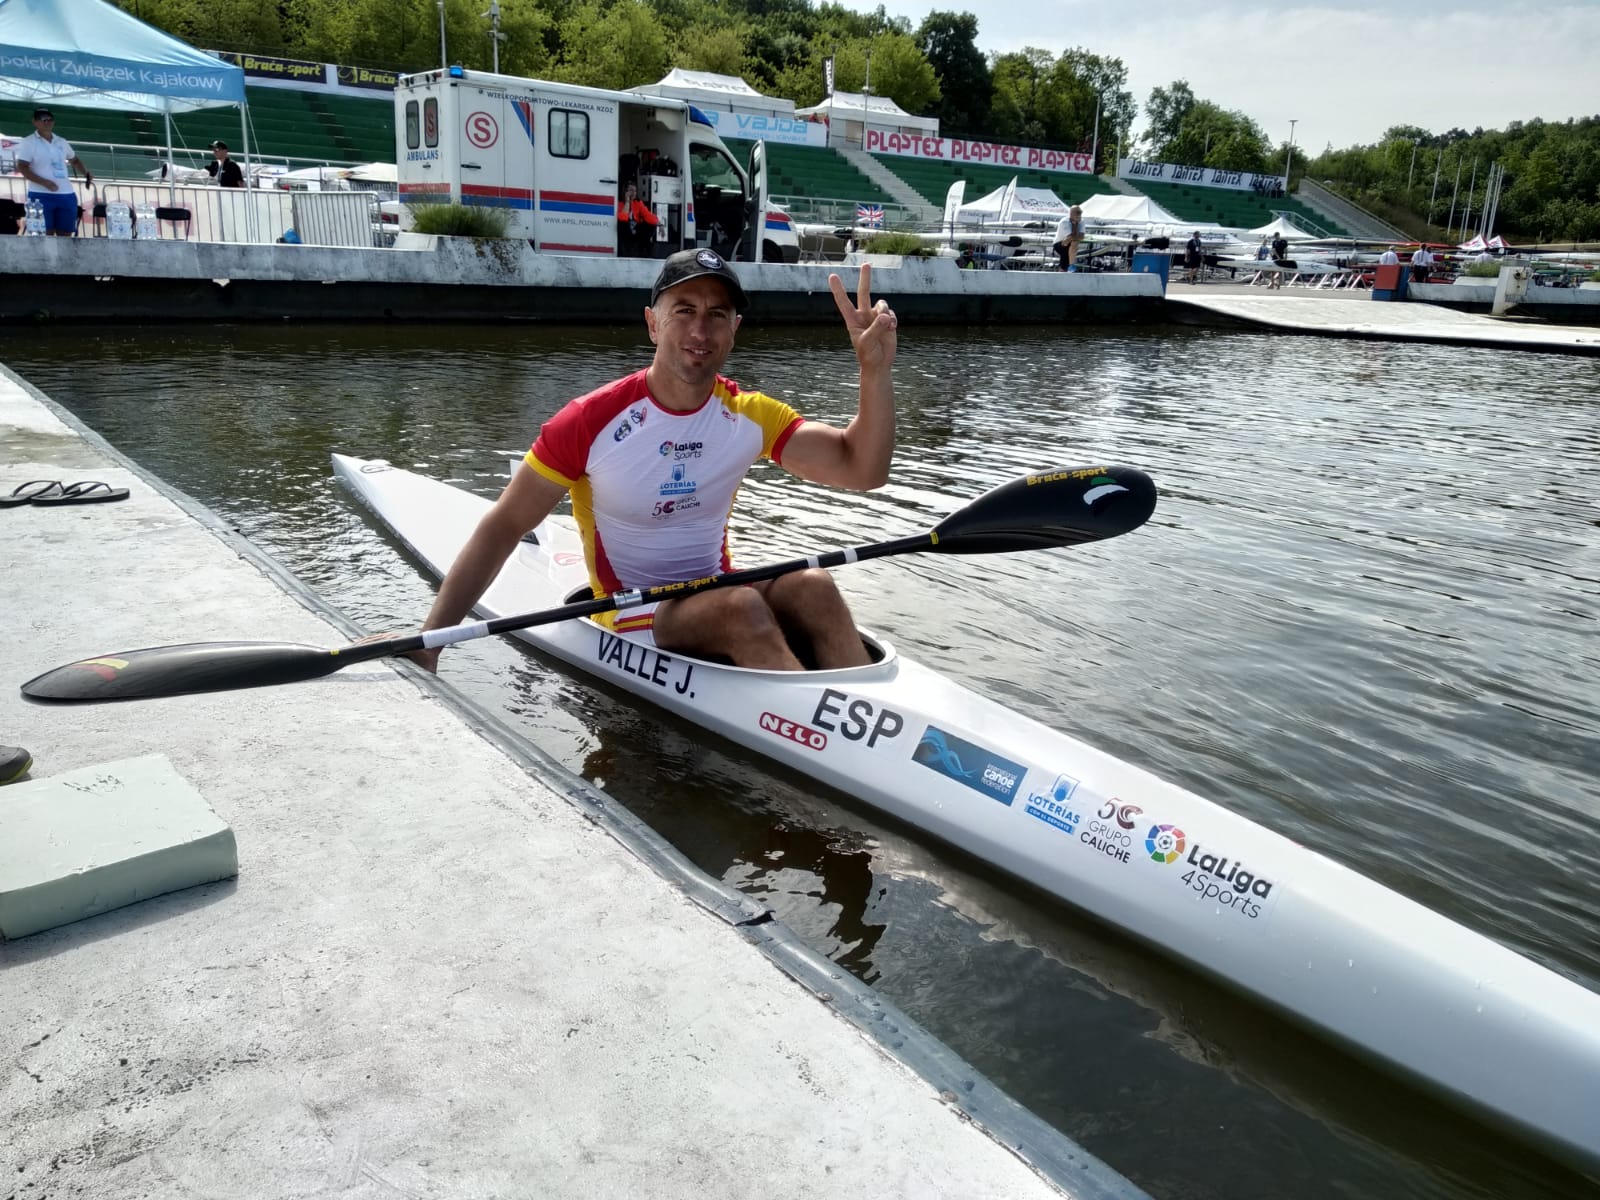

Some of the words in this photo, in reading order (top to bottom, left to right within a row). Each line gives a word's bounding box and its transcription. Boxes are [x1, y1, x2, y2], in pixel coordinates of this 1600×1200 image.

[60, 58, 136, 82] Związek
[140, 69, 224, 92] Kajakowy
[473, 117, 491, 143] S
[407, 150, 439, 161] AMBULANS
[866, 129, 945, 158] PLASTEX
[951, 139, 1021, 166] PLASTEX
[1028, 148, 1093, 172] PLASTEX
[674, 441, 703, 451] LaLiga
[598, 630, 672, 687] VALLE
[675, 664, 695, 699] J.
[811, 687, 904, 749] ESP
[983, 768, 1015, 789] canoe
[1027, 792, 1081, 825] LOTERÍAS
[1080, 831, 1131, 864] CALICHE
[1088, 820, 1132, 848] GRUPO
[1186, 844, 1273, 900] LaLiga
[1180, 870, 1262, 919] 4Sports
